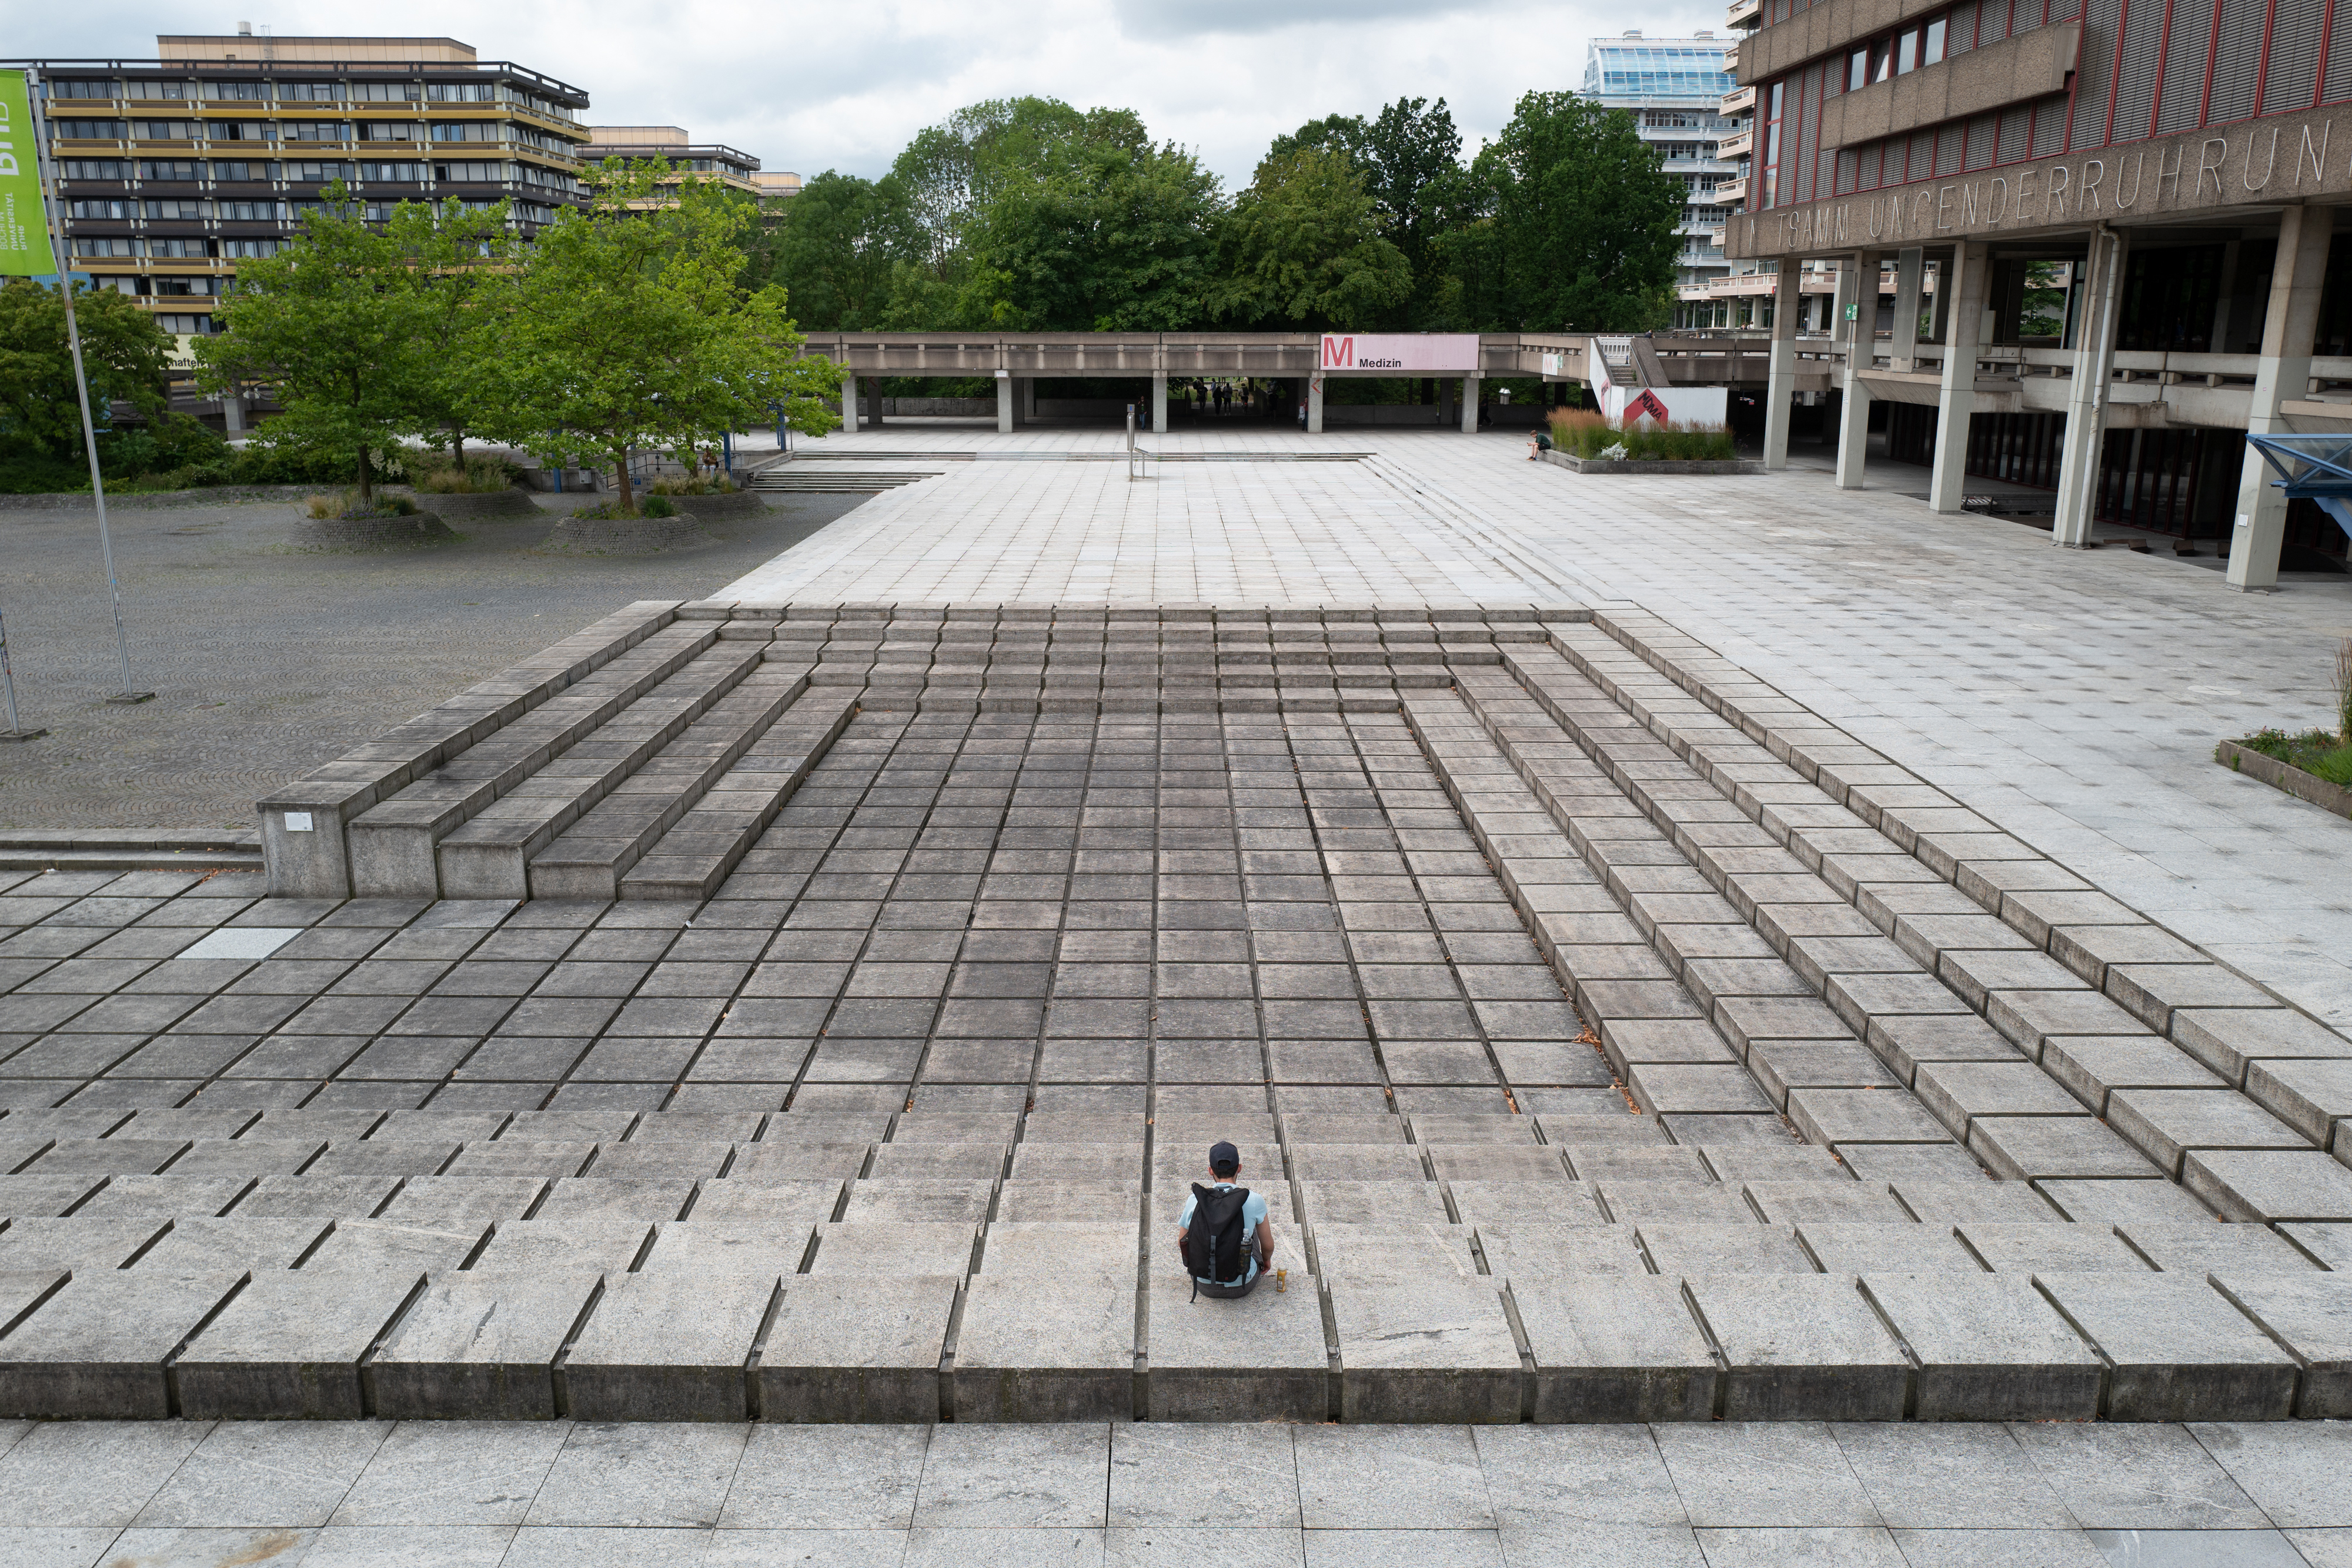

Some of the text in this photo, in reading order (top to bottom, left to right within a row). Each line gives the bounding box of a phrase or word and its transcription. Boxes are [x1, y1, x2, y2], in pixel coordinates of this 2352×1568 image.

[1323, 337, 1353, 367] M
[1359, 358, 1402, 368] Medizin
[1638, 392, 1662, 421] MDMA
